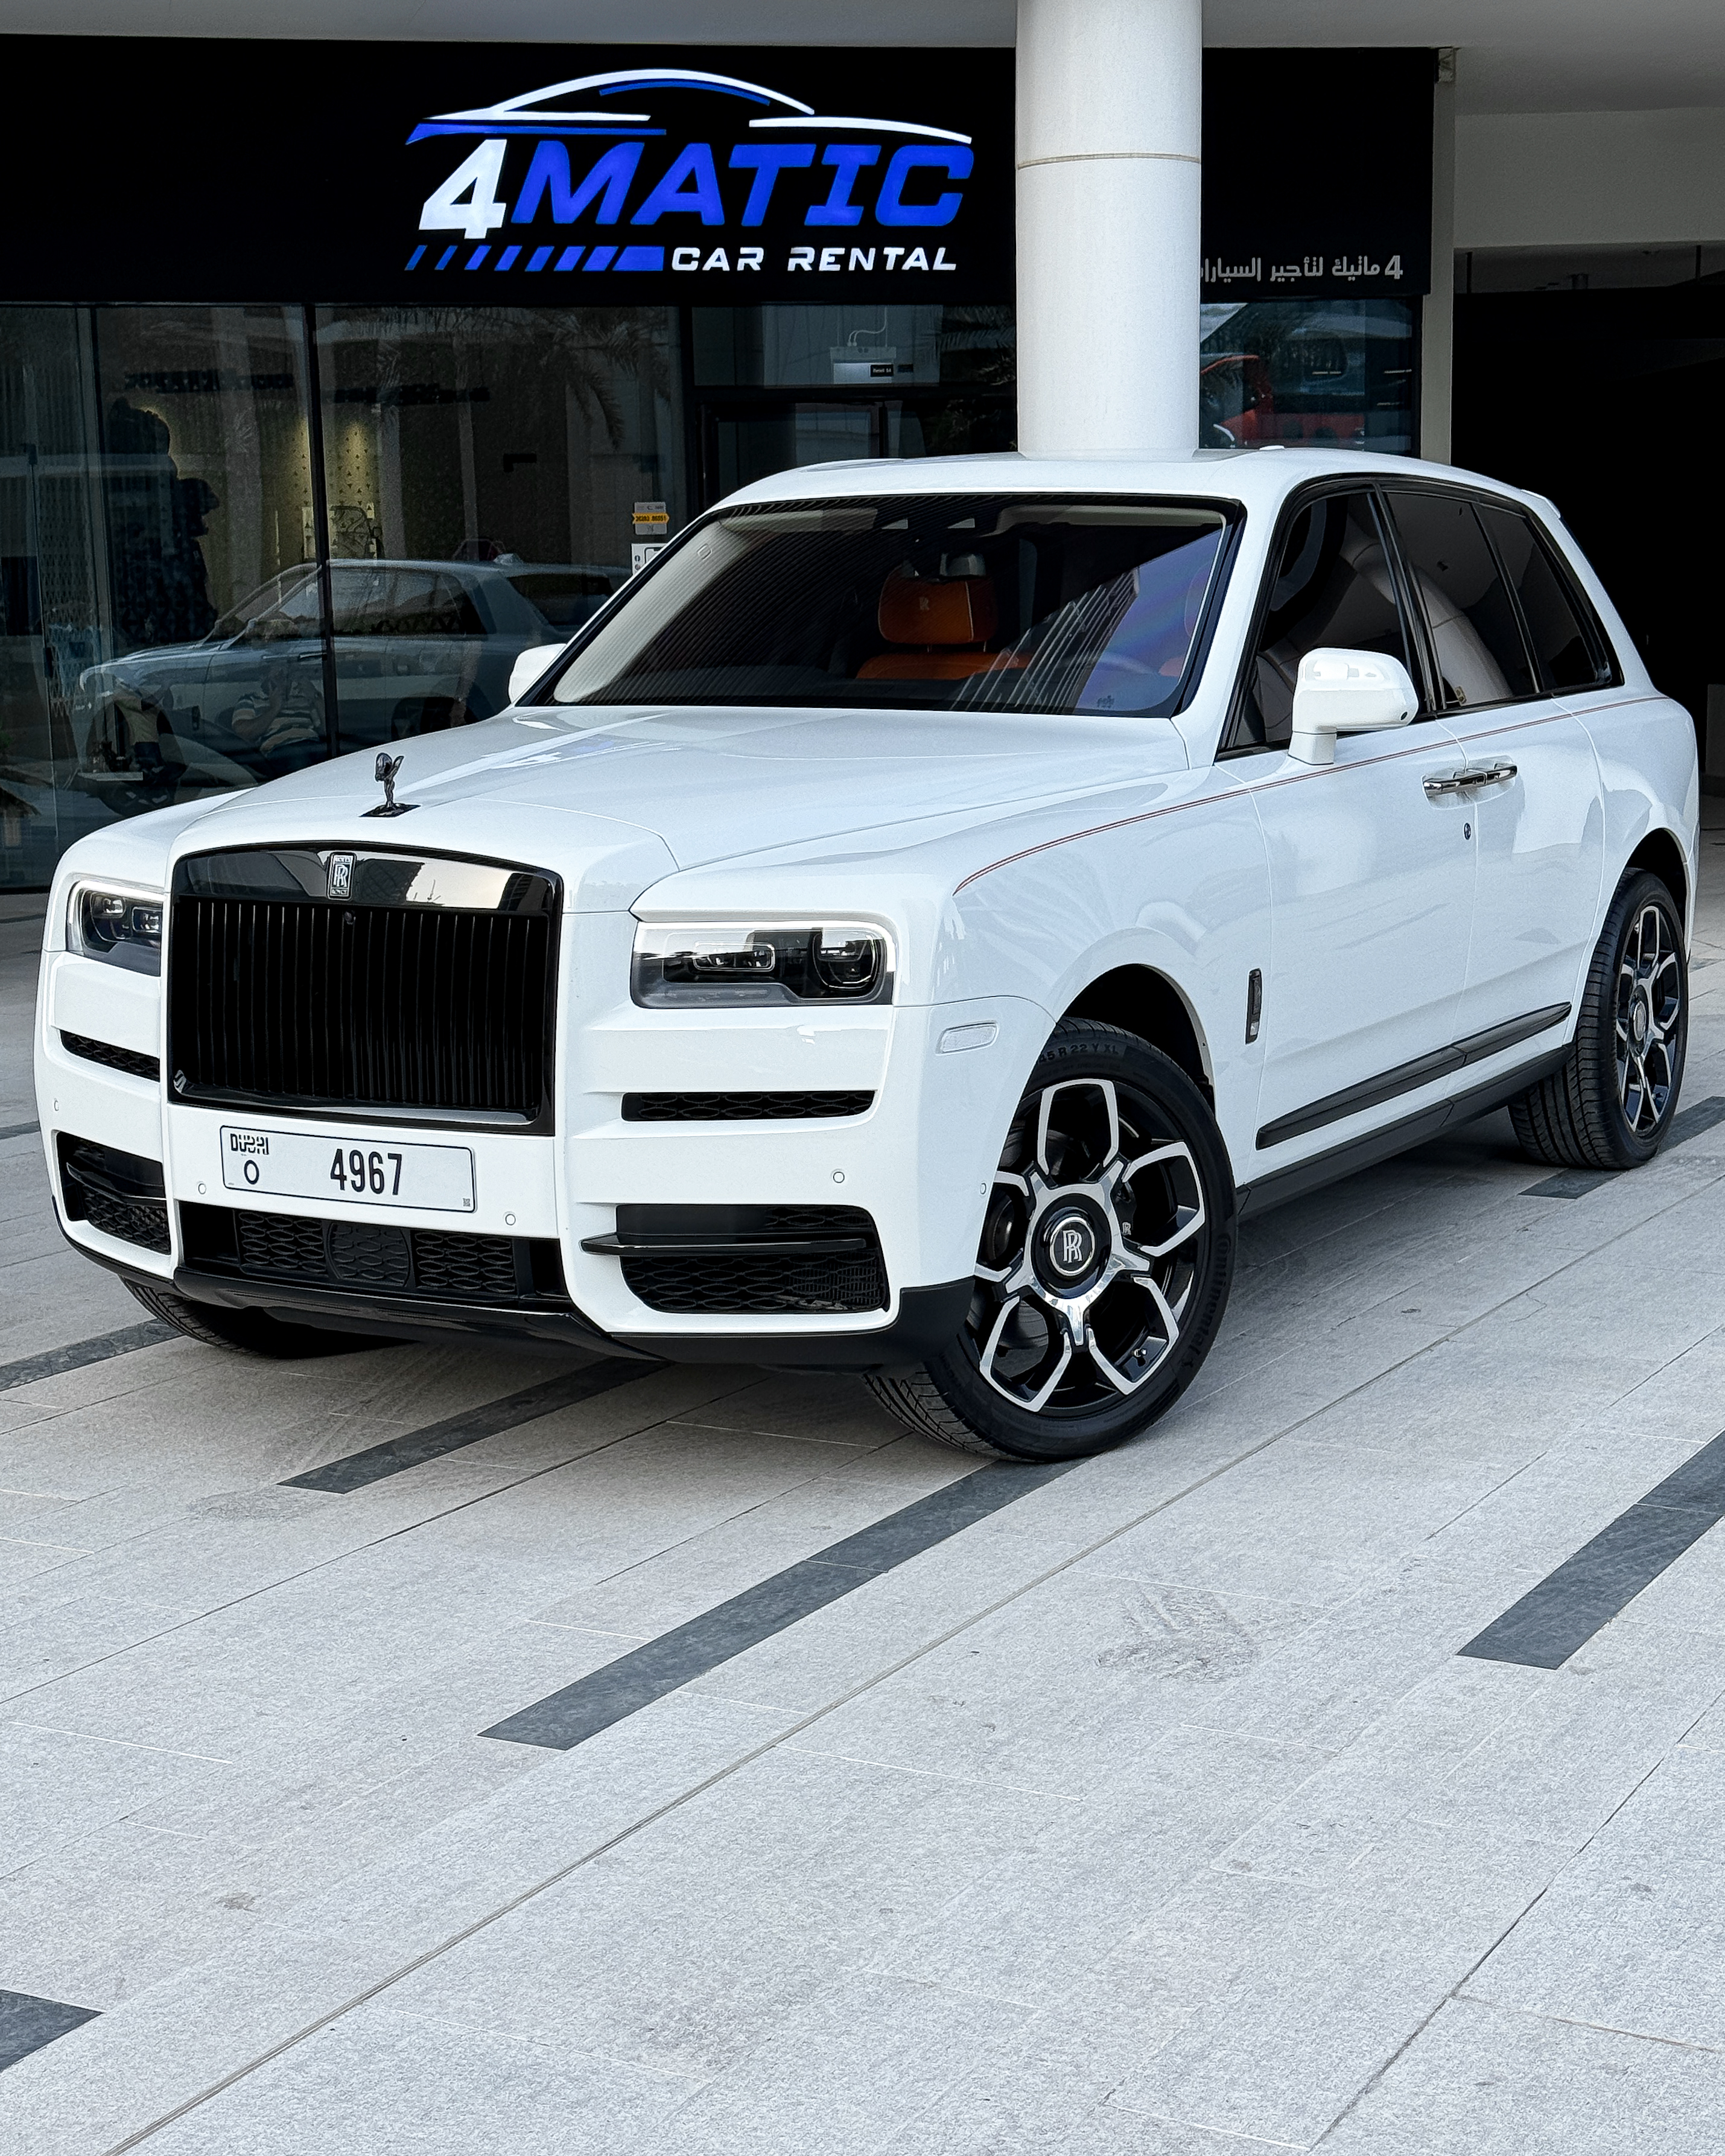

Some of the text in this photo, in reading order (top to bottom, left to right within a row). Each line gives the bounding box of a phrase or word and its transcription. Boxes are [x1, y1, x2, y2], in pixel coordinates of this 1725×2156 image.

[418, 139, 974, 239] 4MATIC
[672, 246, 957, 272] CAR RENTAL
[1201, 257, 1261, 283] السيارا
[1270, 256, 1323, 282] لتأجير
[1385, 255, 1403, 279] 4
[1070, 1043, 1087, 1053] 22
[330, 1148, 402, 1195] 4967
